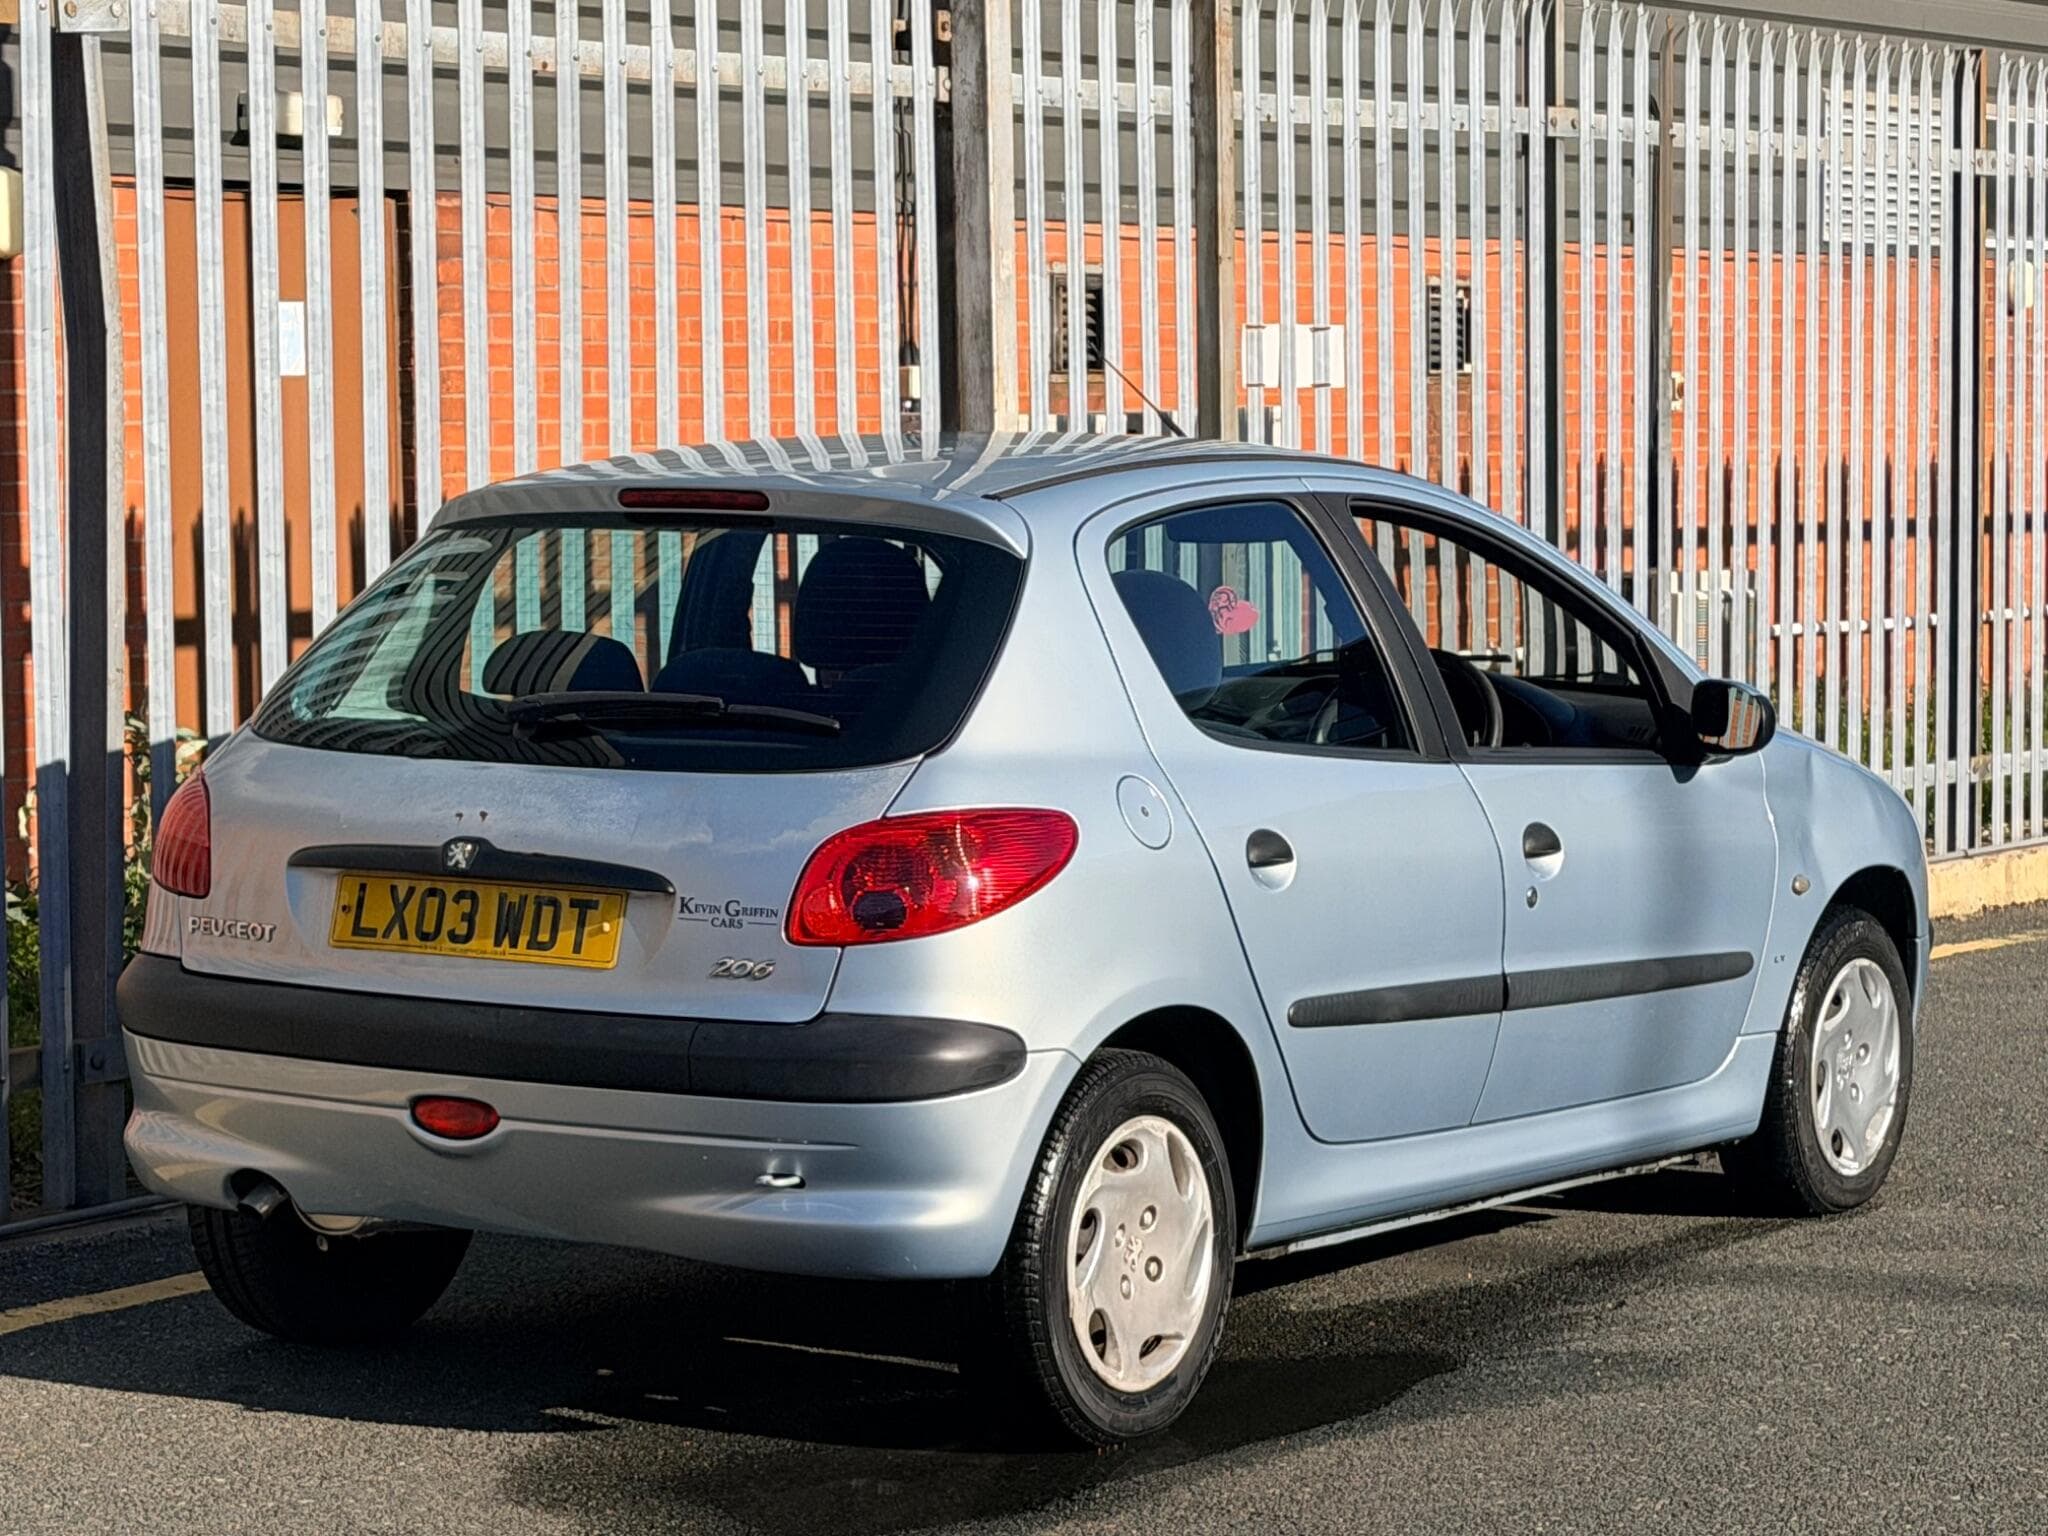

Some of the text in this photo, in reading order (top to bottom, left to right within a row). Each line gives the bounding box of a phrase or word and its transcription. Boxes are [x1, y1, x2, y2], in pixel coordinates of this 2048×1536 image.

[351, 882, 600, 955] LX03 WDT
[679, 896, 779, 919] KEVIN GRIFFIN
[188, 916, 277, 943] PEUGEOT
[710, 917, 744, 930] CARS
[709, 956, 776, 981] 206
